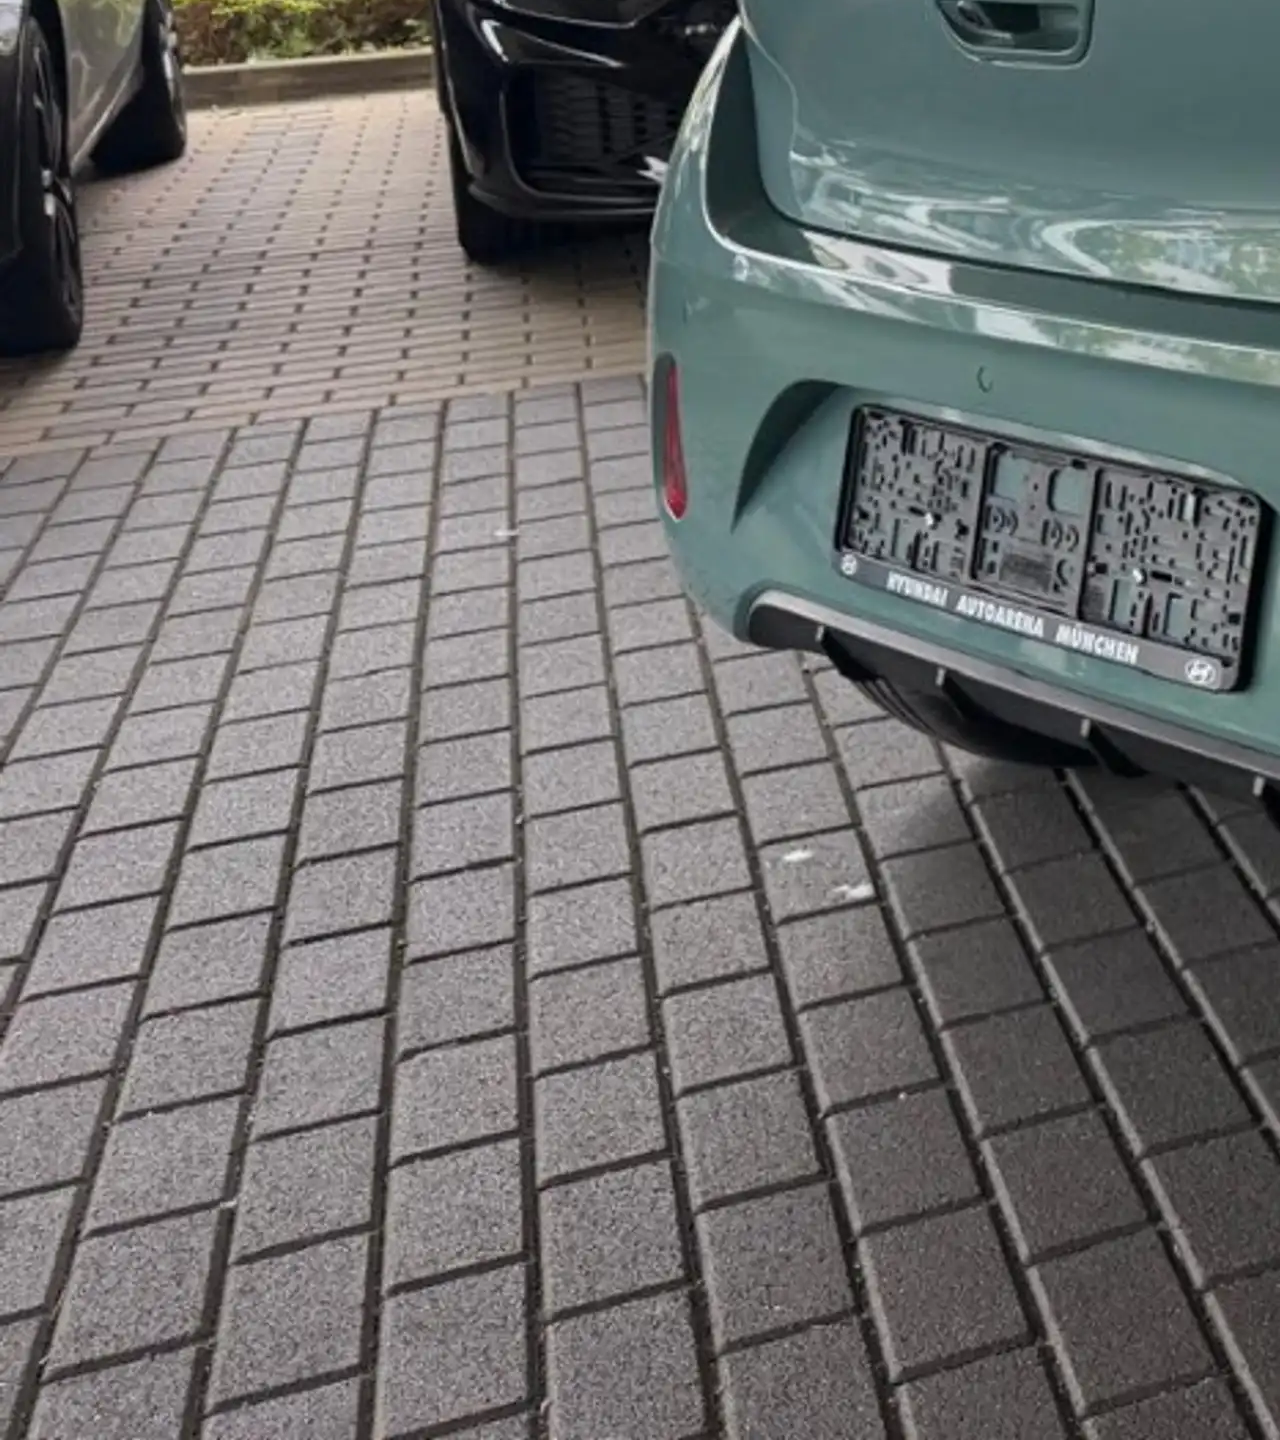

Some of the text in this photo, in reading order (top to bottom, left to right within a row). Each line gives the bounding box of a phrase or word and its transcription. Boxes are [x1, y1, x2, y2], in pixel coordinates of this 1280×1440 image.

[886, 570, 1140, 665] HYUNDAI AUTOARENA MÜNCHEN
